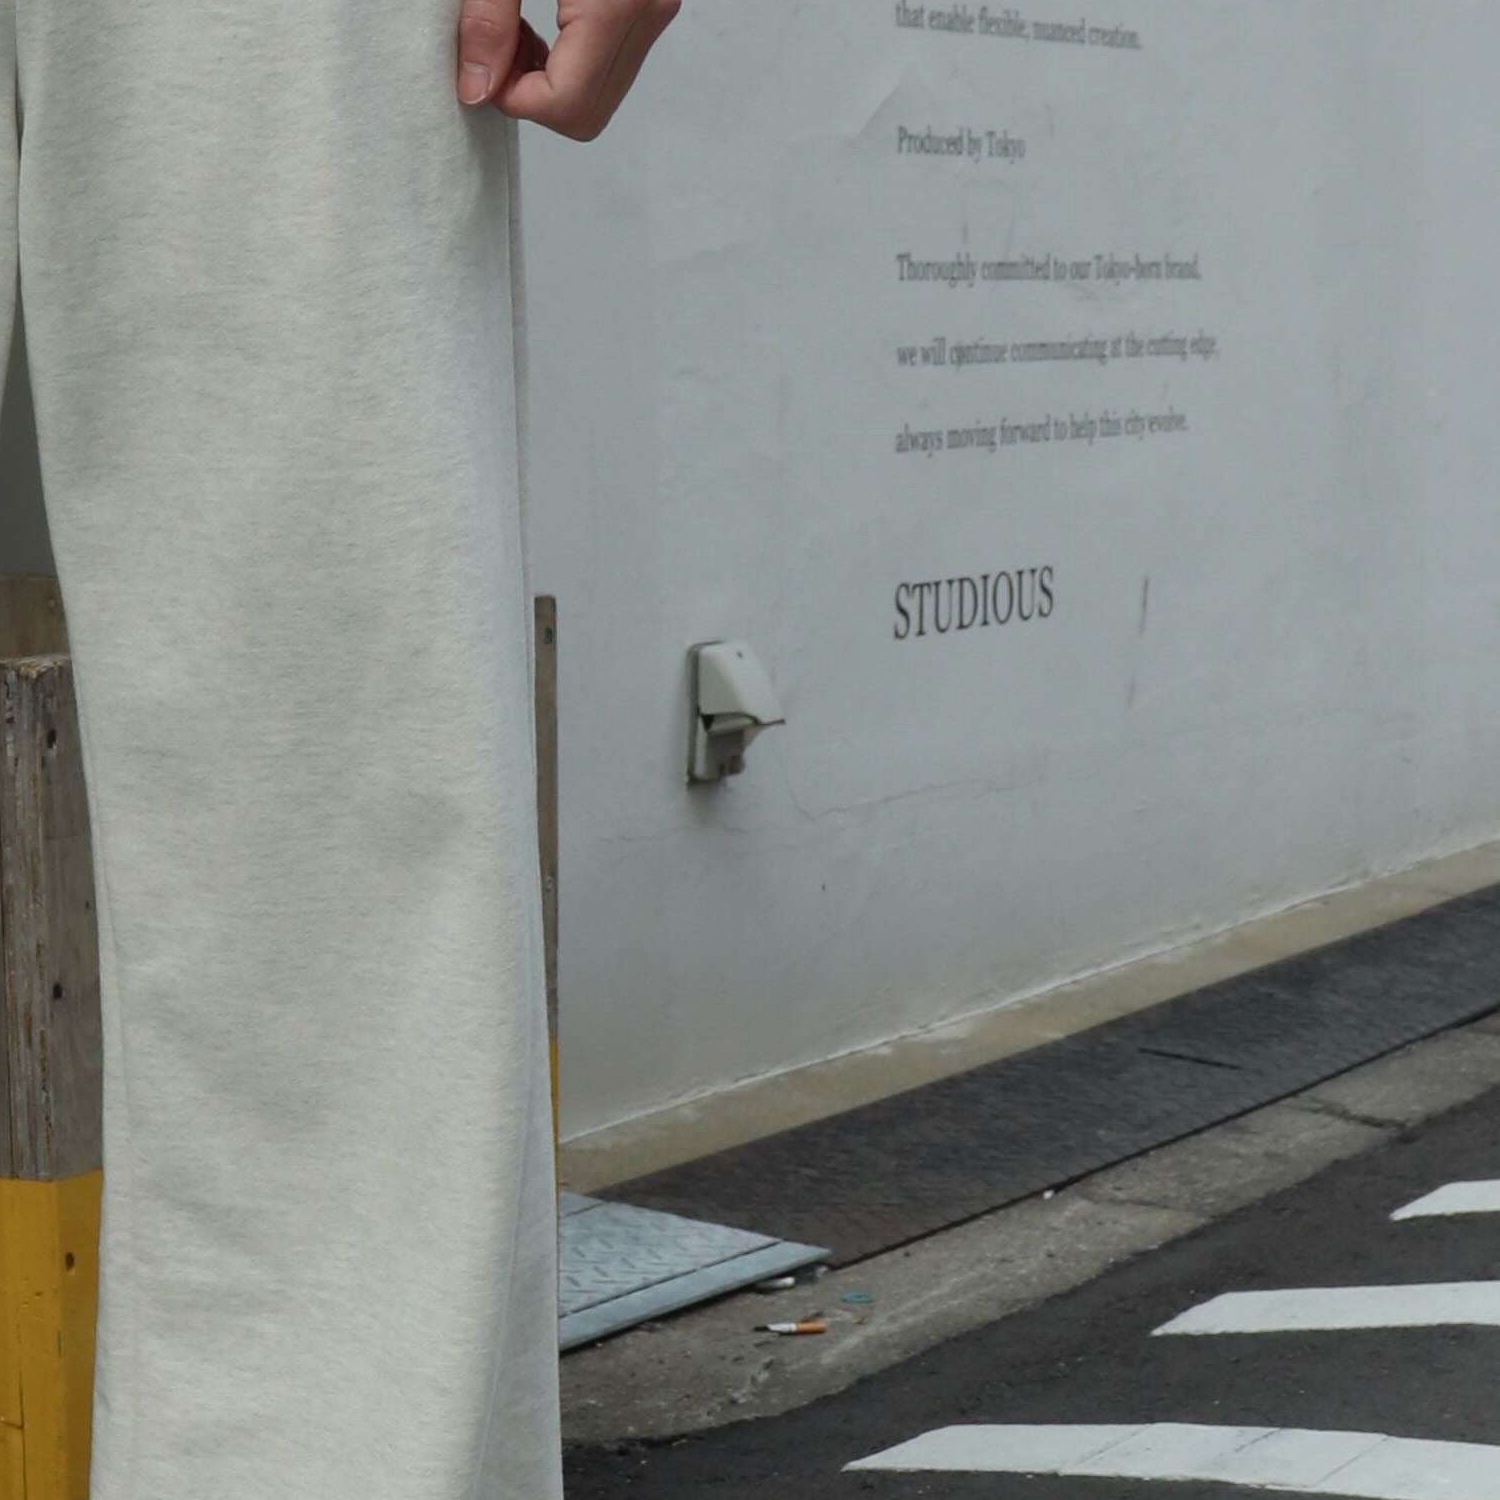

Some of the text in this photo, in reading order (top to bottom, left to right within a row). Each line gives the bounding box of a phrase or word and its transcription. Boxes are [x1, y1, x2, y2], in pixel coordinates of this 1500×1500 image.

[896, 125, 1026, 164] Produced by Tokyo
[894, 565, 1054, 640] STUDIOUS
